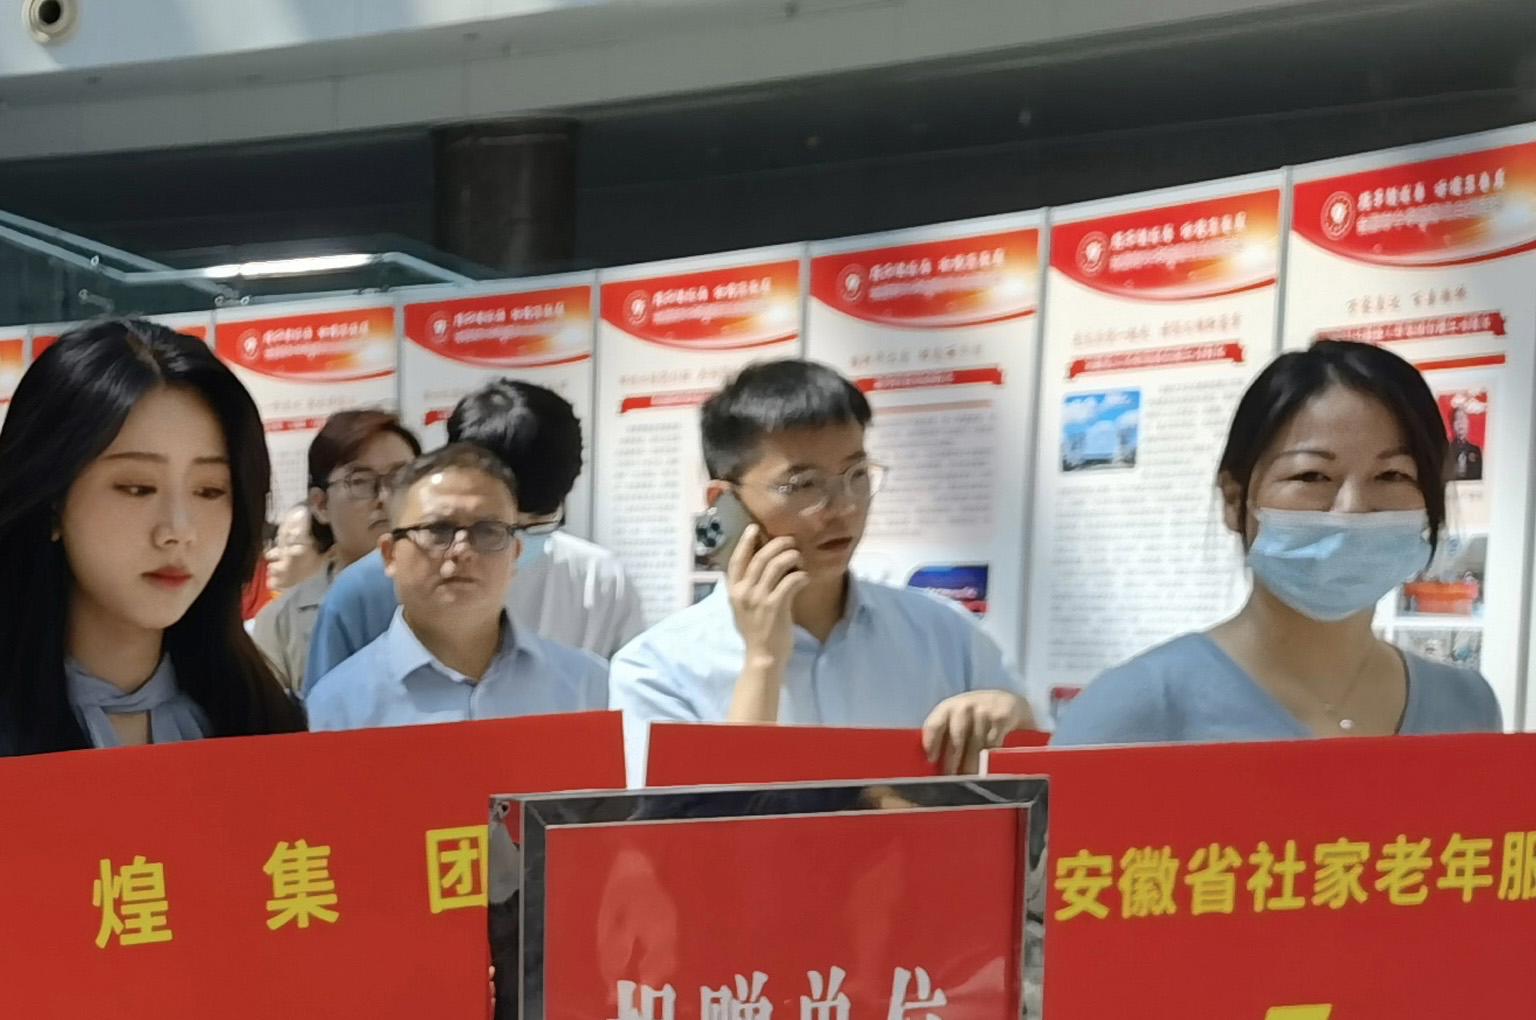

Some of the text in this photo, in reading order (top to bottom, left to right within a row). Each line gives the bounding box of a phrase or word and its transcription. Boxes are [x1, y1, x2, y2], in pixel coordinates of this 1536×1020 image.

[1053, 830, 1536, 922] 安徽省社家老年服
